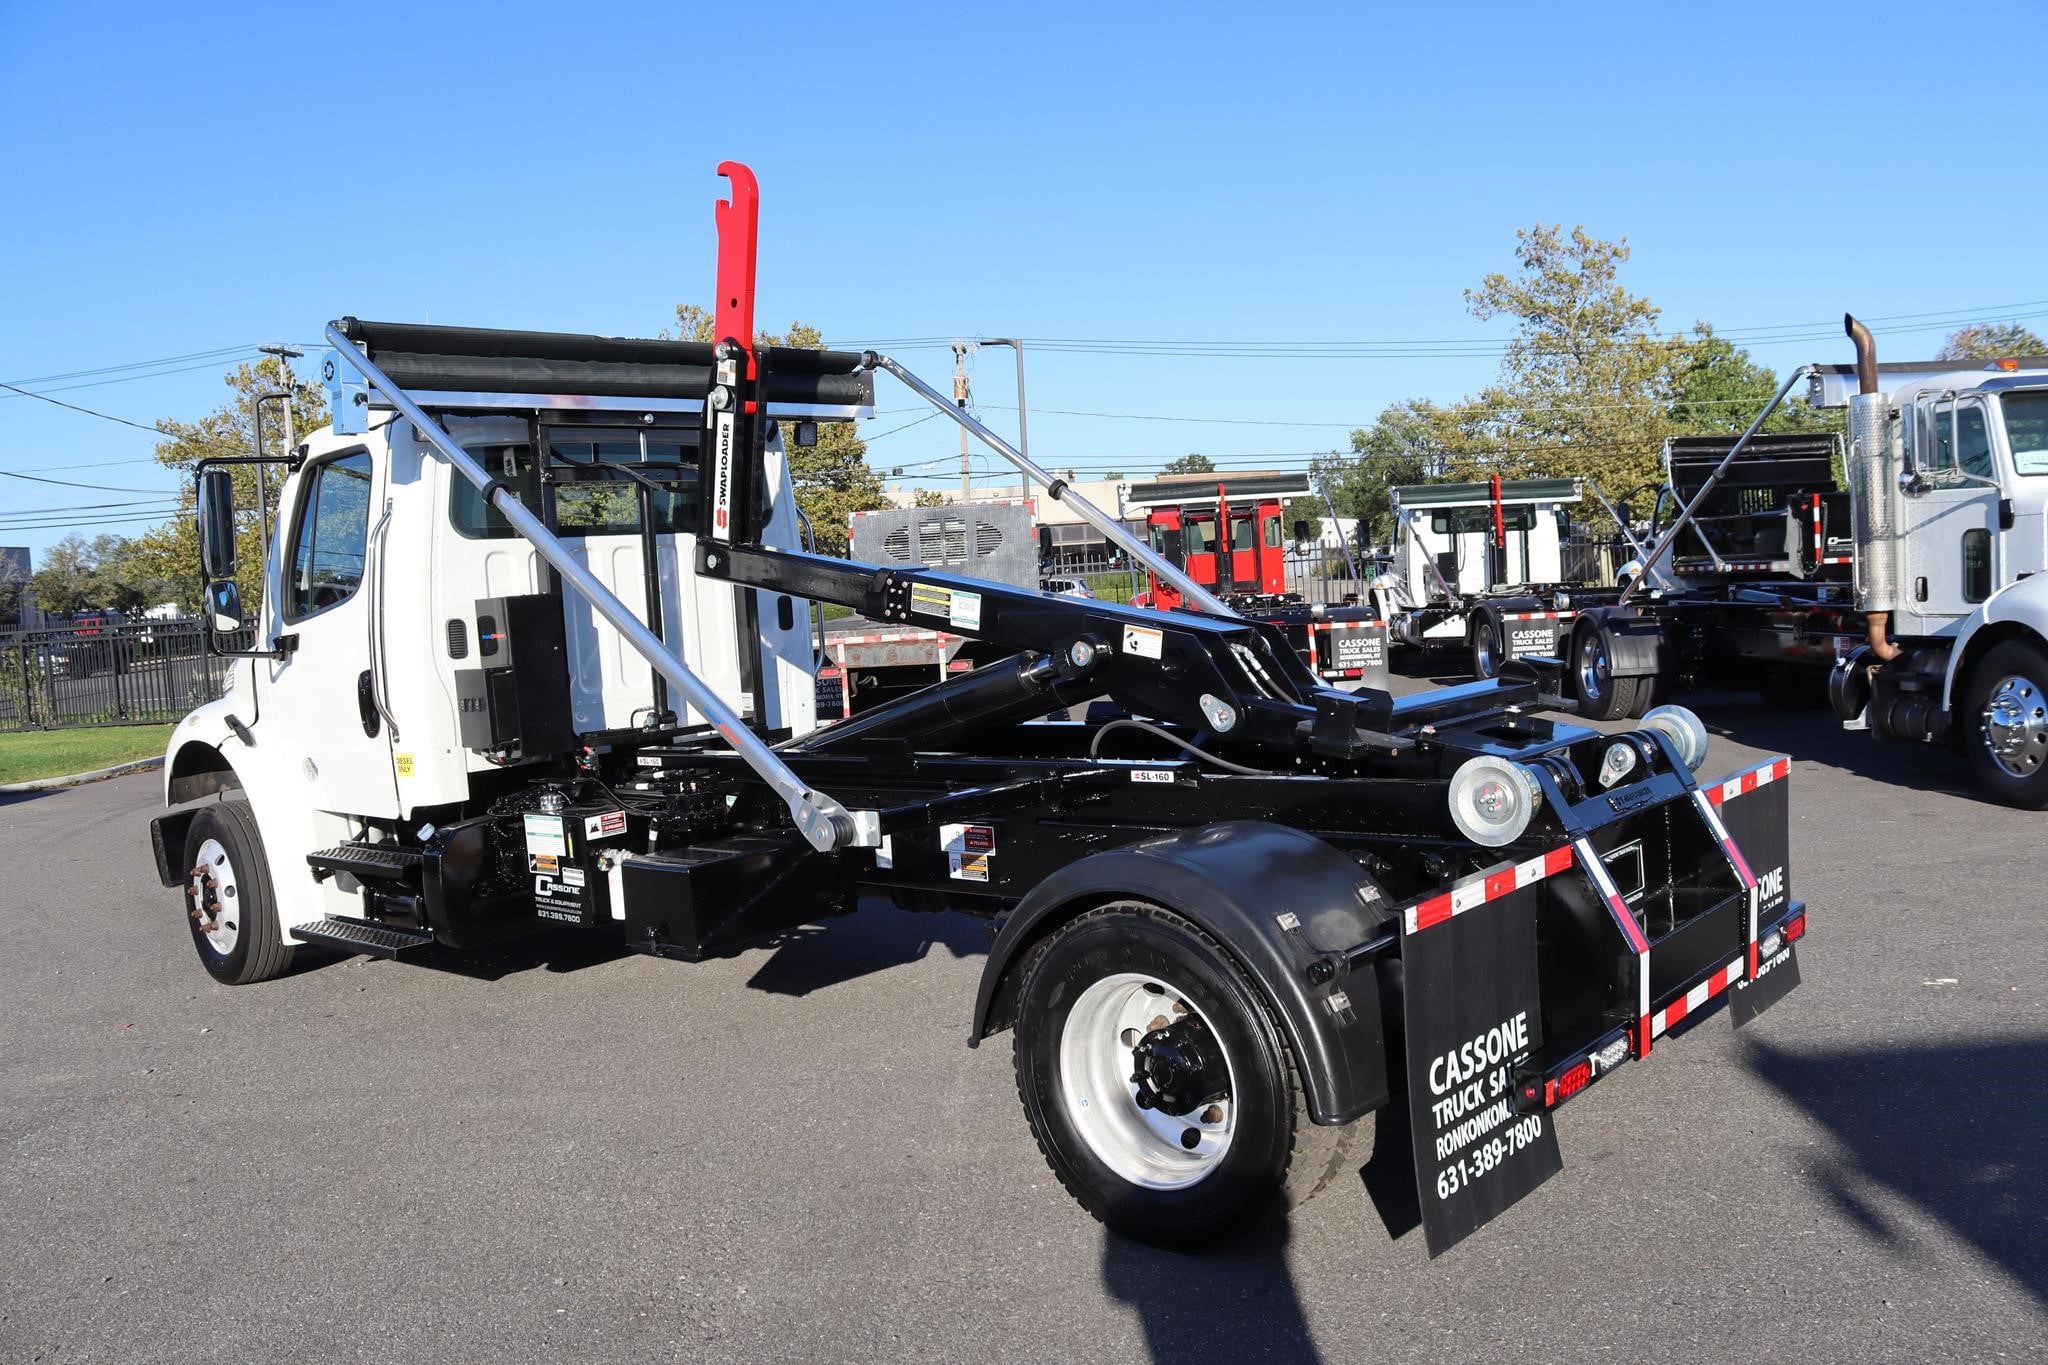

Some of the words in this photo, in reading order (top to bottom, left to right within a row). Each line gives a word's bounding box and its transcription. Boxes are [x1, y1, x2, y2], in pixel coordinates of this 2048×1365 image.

[719, 423, 730, 506] SWAPLOADER
[1512, 629, 1554, 640] CASSONE
[1338, 638, 1381, 648] CASSONE
[1534, 637, 1554, 645] SALES
[1339, 647, 1361, 655] TRUCK
[1361, 646, 1381, 654] SALES
[1141, 771, 1170, 781] SL-160
[1429, 1010, 1529, 1096] CASSONE
[1432, 1078, 1486, 1129] TRUCK
[1437, 1114, 1542, 1200] 631-389-7800
